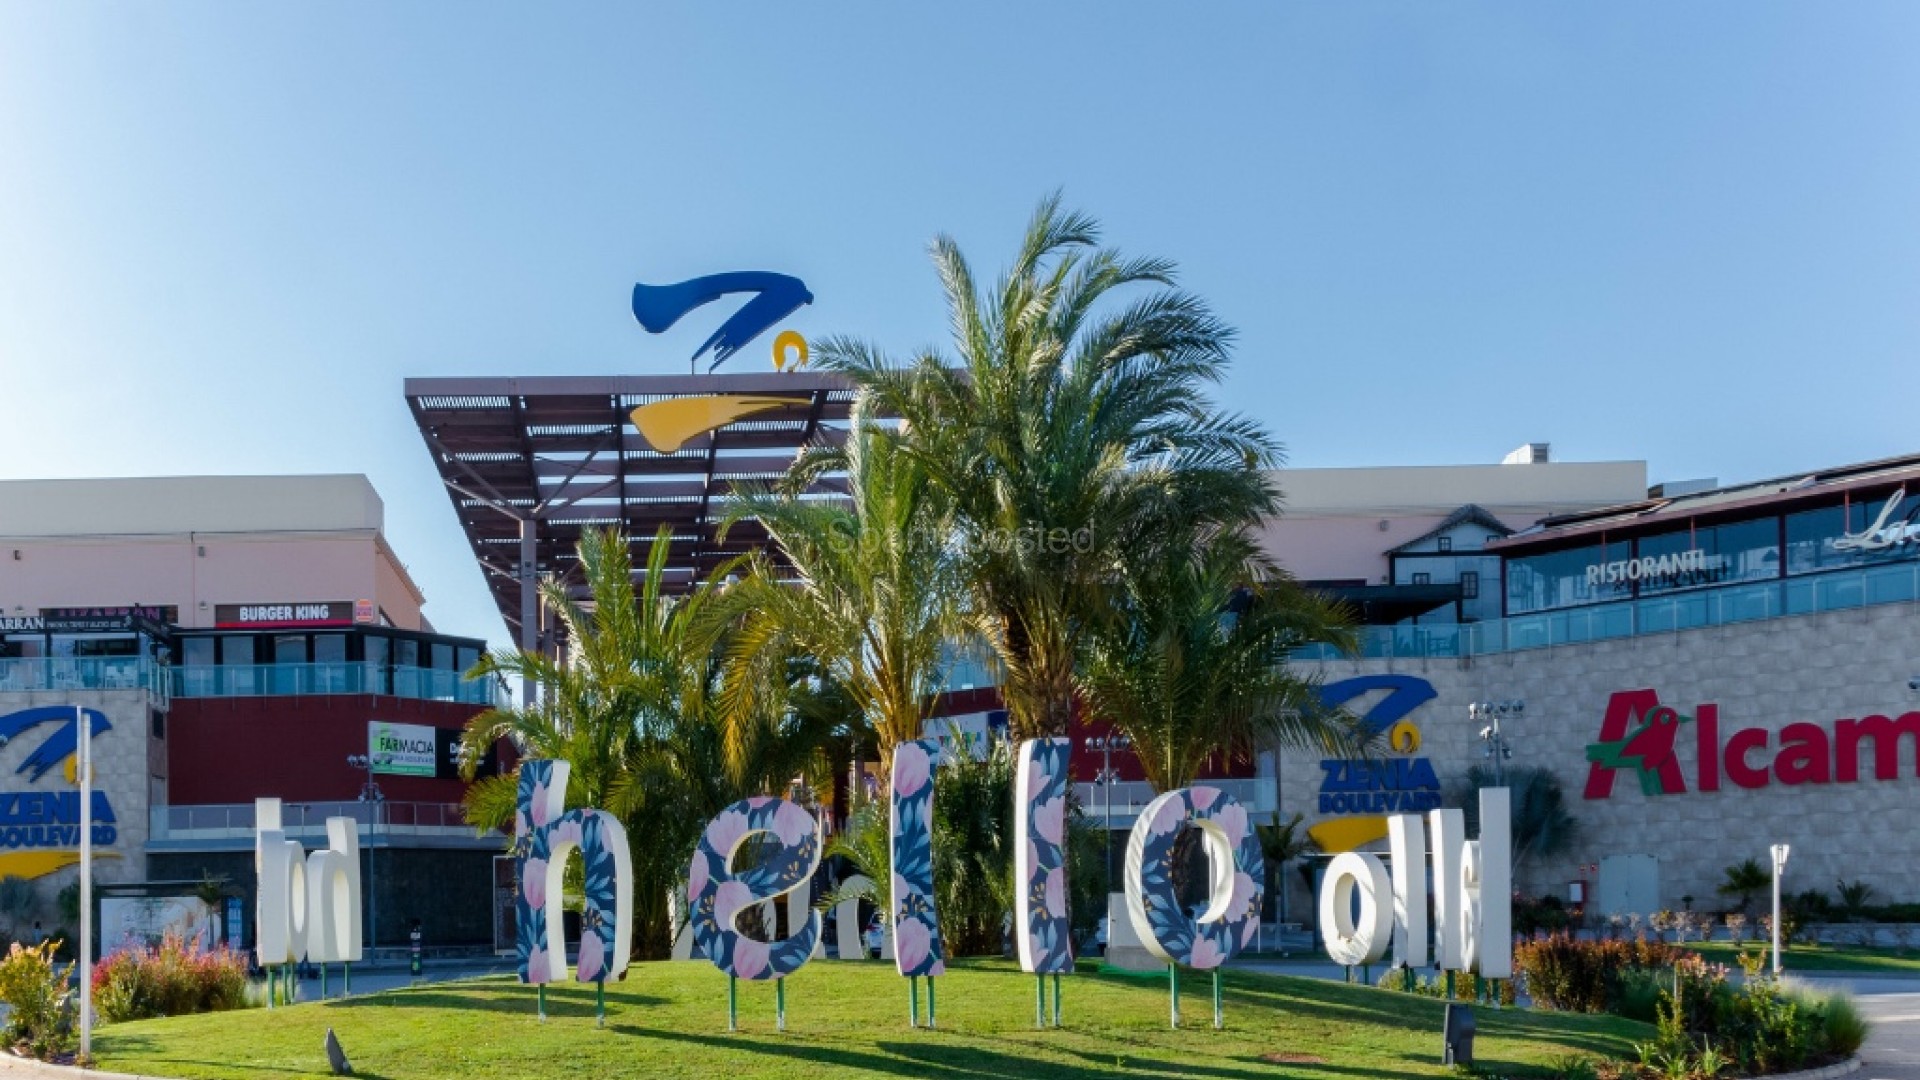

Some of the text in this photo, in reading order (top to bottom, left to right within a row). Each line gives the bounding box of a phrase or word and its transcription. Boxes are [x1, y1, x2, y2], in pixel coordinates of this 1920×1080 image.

[240, 603, 329, 621] BURGER KING
[380, 737, 434, 754] FARMACIA
[1319, 757, 1441, 792] ZENIA
[1318, 791, 1442, 814] BOULEVARD
[516, 737, 1265, 985] hello
